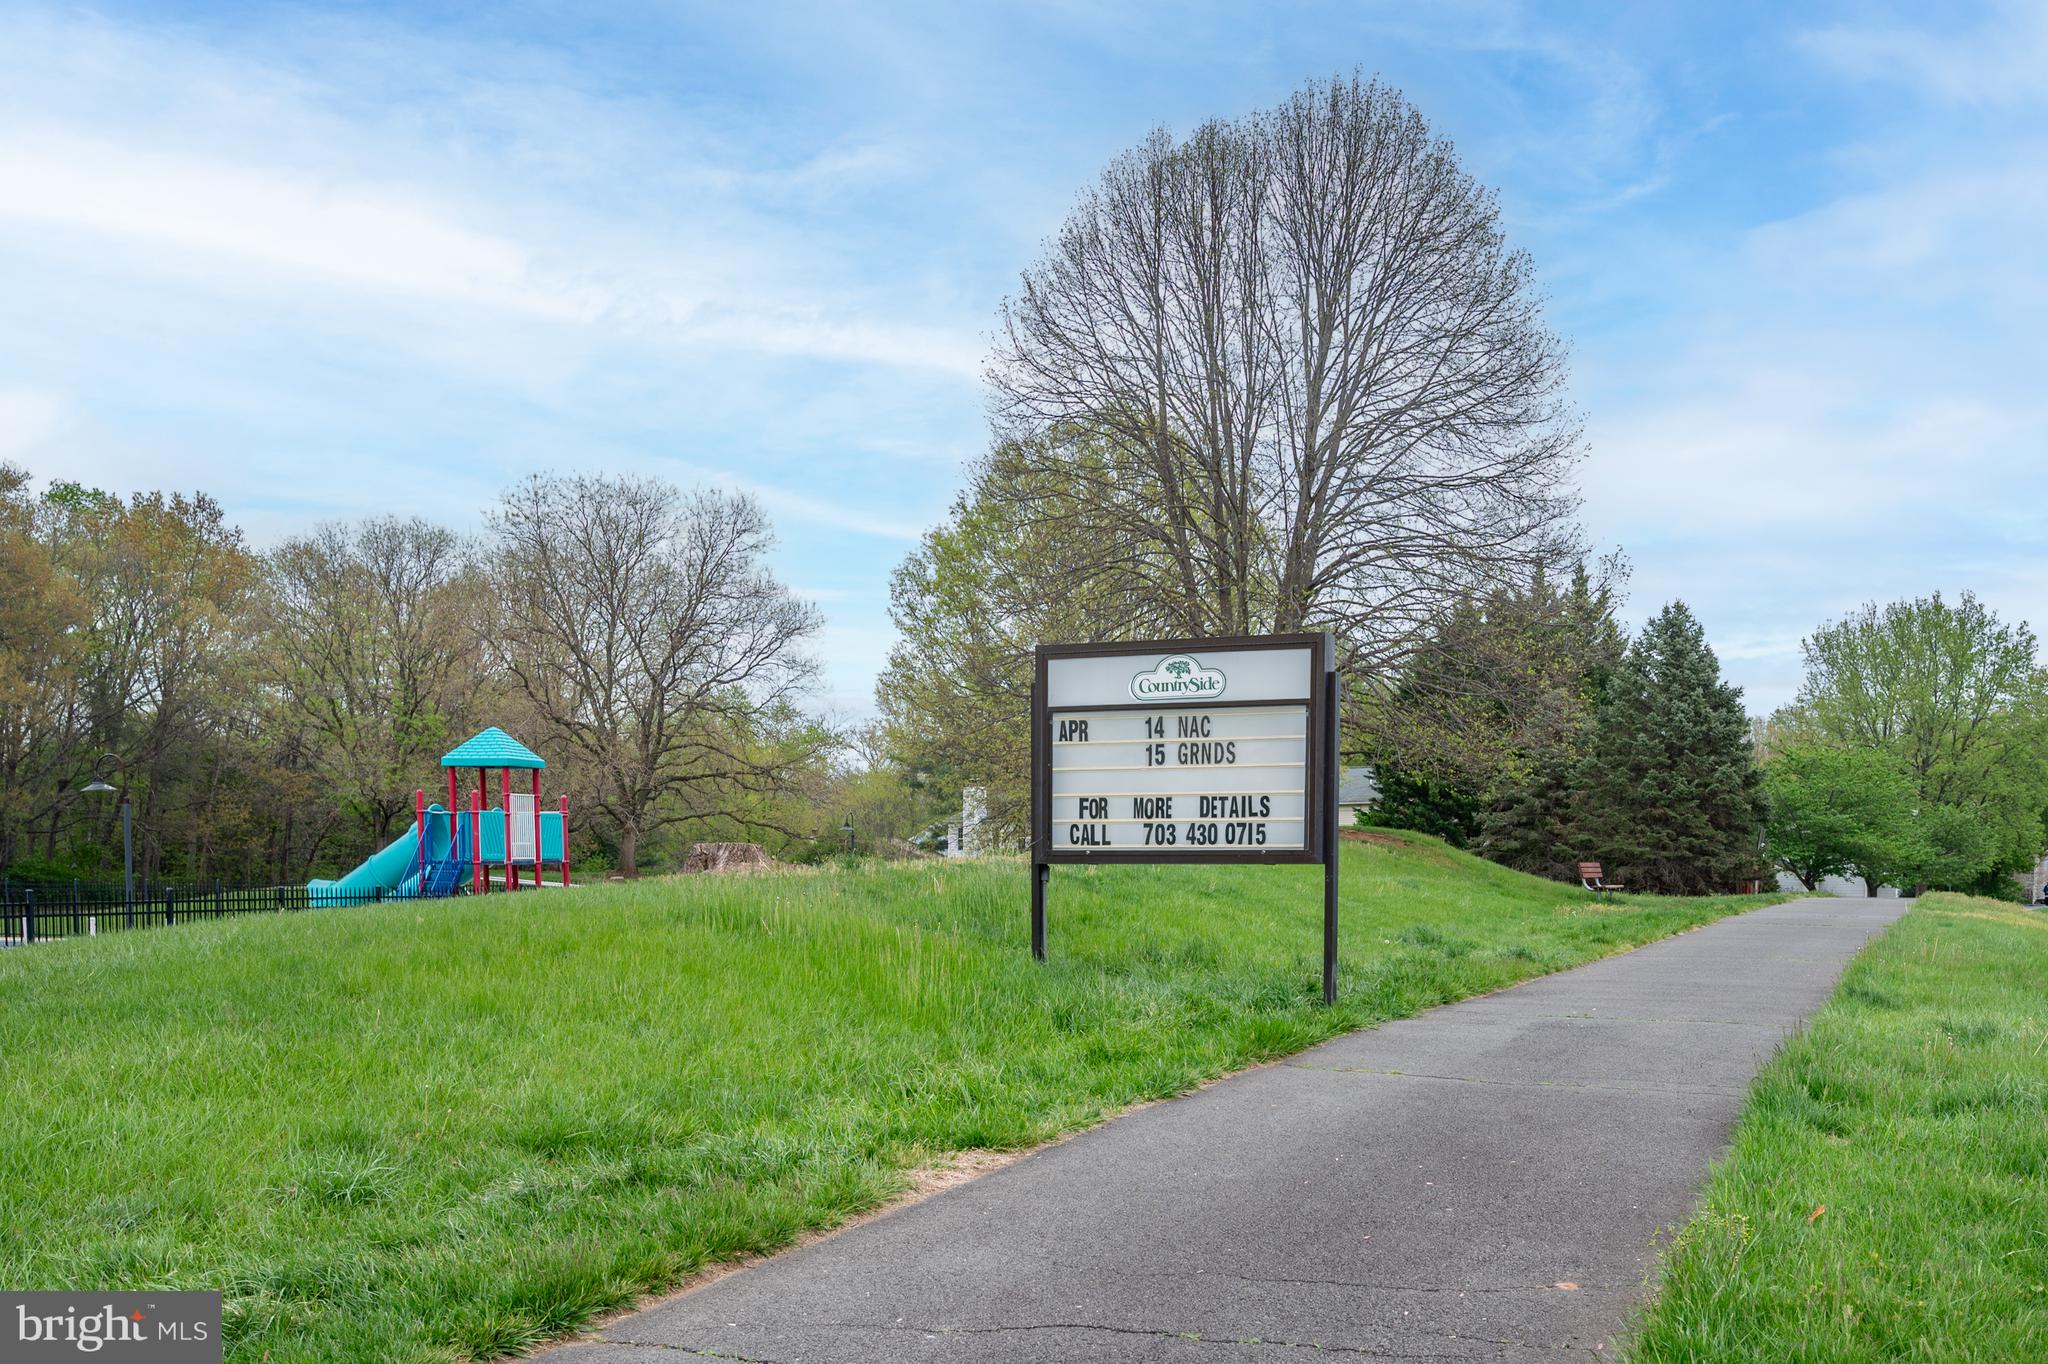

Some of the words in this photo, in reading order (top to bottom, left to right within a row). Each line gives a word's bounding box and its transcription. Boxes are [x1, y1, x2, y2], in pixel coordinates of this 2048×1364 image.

[1138, 676, 1220, 695] CountrySide
[1058, 719, 1089, 742] APR
[1144, 716, 1165, 739] 14
[1178, 715, 1211, 738] NAC
[1145, 744, 1166, 767] 15
[1177, 742, 1236, 765] GRNDS
[1078, 797, 1108, 820] FOR
[1133, 797, 1173, 819] MORE
[1199, 795, 1271, 818] DETAILS
[1069, 823, 1111, 846] CALL
[1143, 822, 1176, 846] 703
[1185, 822, 1218, 845] 430
[1225, 822, 1266, 845] 0715
